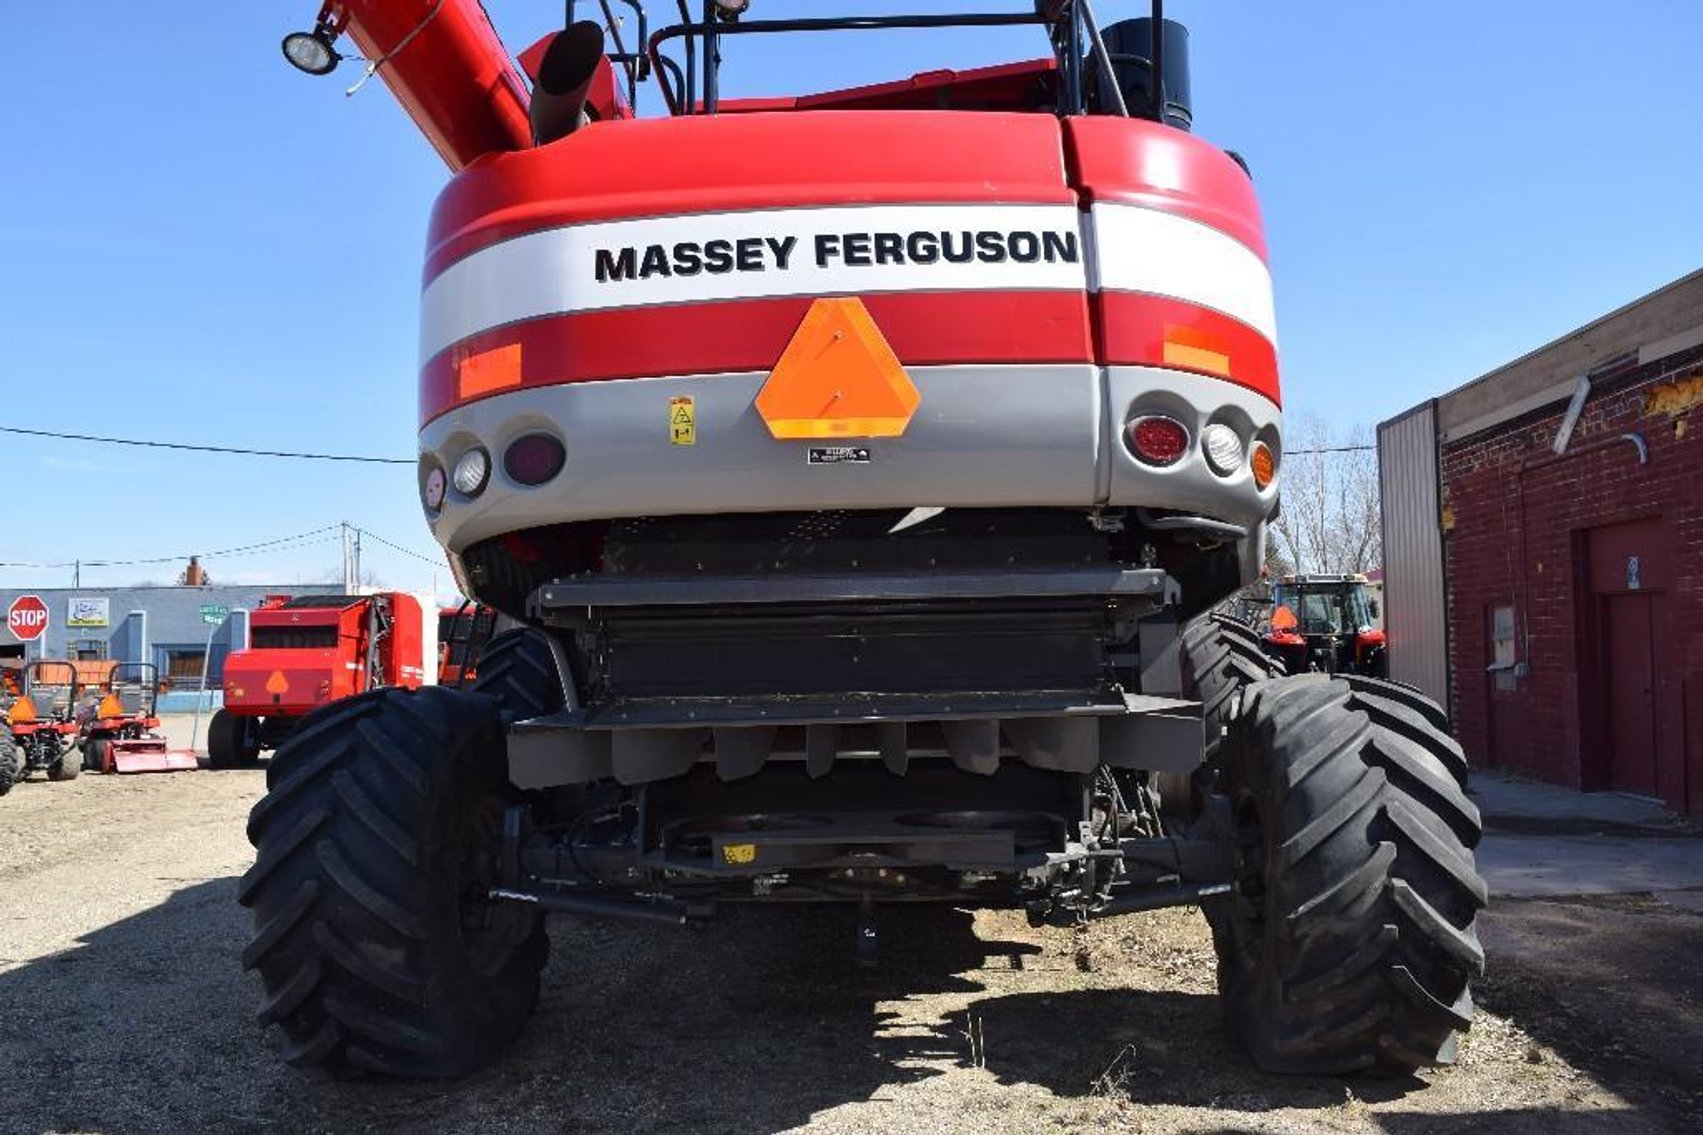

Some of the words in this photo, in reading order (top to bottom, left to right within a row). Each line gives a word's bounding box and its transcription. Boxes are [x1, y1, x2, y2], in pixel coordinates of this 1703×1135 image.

[594, 236, 798, 282] MASSEY
[814, 231, 1080, 267] FERGUSON
[11, 610, 46, 626] STOP
